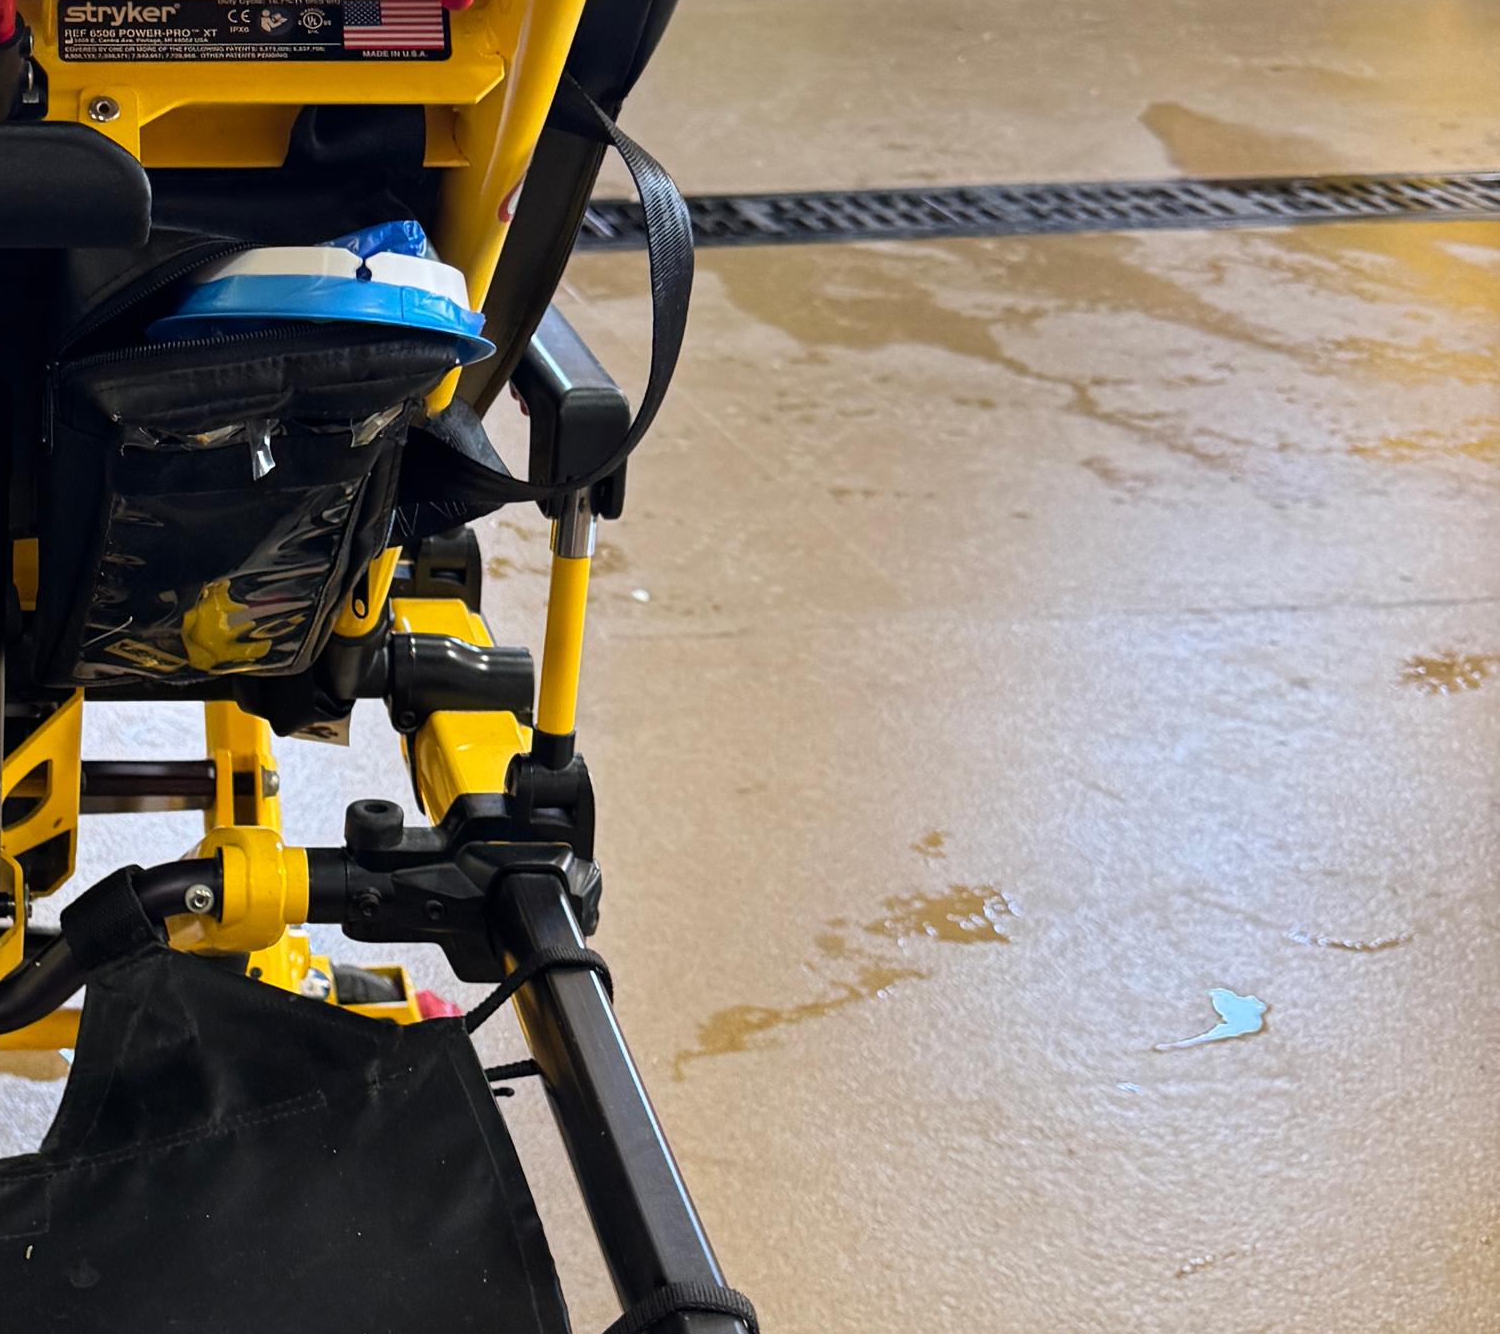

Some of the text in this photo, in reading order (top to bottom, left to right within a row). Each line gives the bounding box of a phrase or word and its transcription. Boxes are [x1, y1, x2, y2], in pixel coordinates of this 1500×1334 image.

[64, 29, 87, 38] REF
[89, 29, 116, 38] 6506
[203, 29, 218, 37] XT
[230, 26, 250, 34] IPX6
[362, 50, 428, 58] MADE IN U.S.A.
